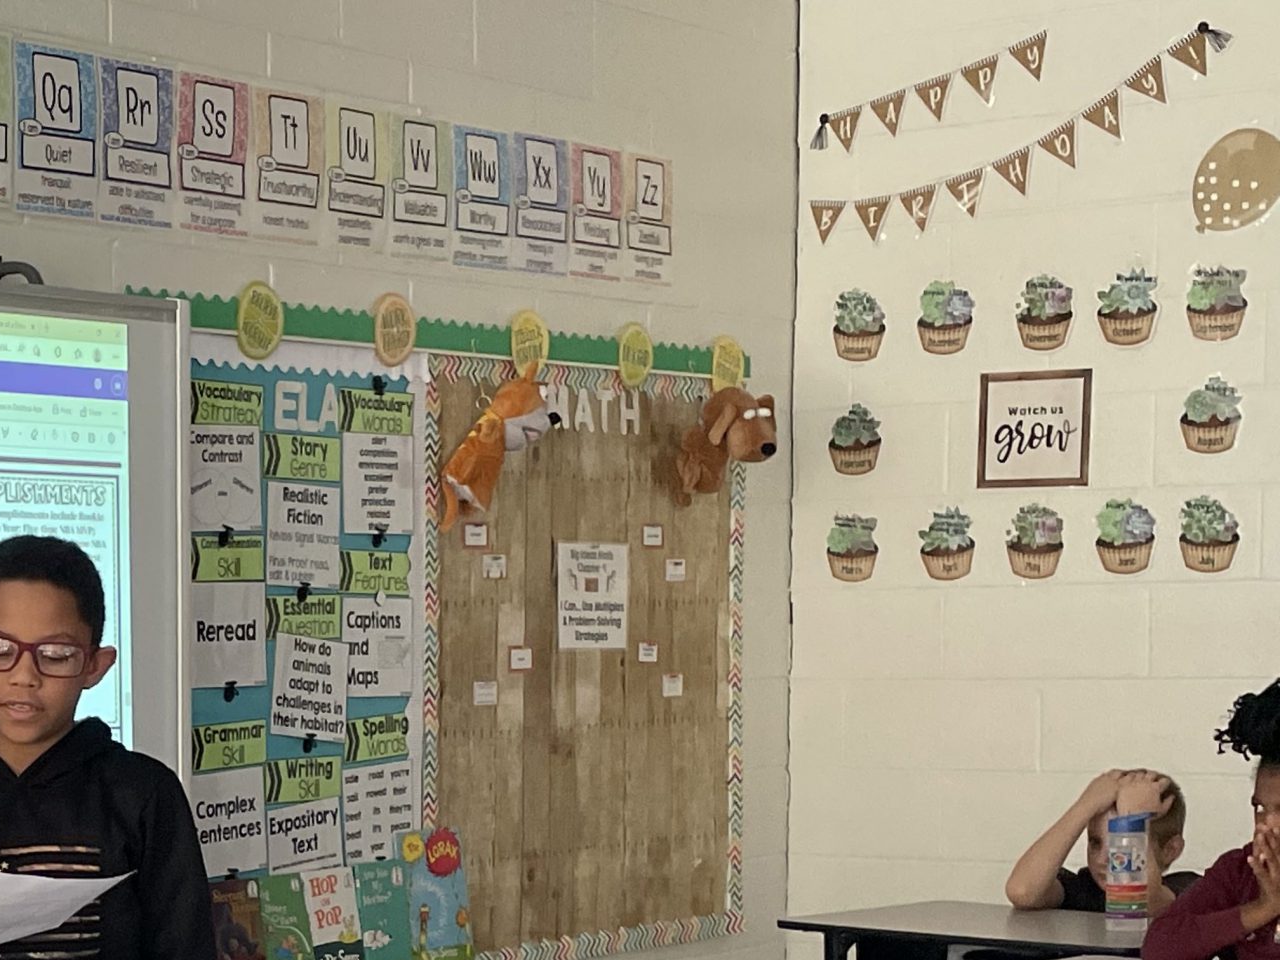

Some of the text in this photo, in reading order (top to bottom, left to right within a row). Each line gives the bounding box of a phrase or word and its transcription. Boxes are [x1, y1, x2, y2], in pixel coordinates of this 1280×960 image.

[42, 72, 74, 124] Qq
[126, 87, 151, 127] Rr
[201, 98, 226, 139] Ss
[280, 114, 298, 149] Tt
[45, 143, 73, 165] Quiet
[346, 126, 369, 163] Uu
[410, 138, 430, 173] Vv
[469, 148, 496, 185] Ww
[532, 155, 552, 190] Xx
[191, 166, 234, 195] Strategic
[588, 165, 606, 208] Yy
[640, 174, 659, 207] Zz
[197, 382, 264, 408] Vocabulary
[274, 380, 340, 433] ELA
[352, 391, 413, 417] Vocabulary
[1008, 405, 1065, 417] Watch us
[361, 413, 403, 434] Words
[236, 431, 254, 446] and
[291, 437, 328, 462] Story
[994, 418, 1078, 464] grow
[201, 448, 243, 465] Contrast
[289, 459, 328, 479] Genre
[282, 486, 329, 506] Realistic
[286, 508, 324, 527] Fiction
[368, 553, 393, 572] Text
[353, 571, 409, 591] Features
[282, 598, 336, 616] Essential
[196, 620, 257, 643] Reread
[346, 610, 401, 634] Captions
[293, 638, 331, 657] How do
[292, 657, 331, 677] animals
[288, 676, 332, 695] adapt to
[274, 694, 343, 716] challenges in
[203, 724, 265, 745] Grammar
[272, 711, 345, 734] their habitat?
[362, 715, 409, 738] Spelling
[367, 738, 407, 757] Words
[285, 758, 333, 781] Writing
[195, 796, 257, 820] Complex
[198, 820, 262, 845] entences
[269, 807, 338, 838] Expository
[291, 833, 319, 856] Text
[425, 835, 459, 865] LORAX
[309, 874, 338, 899] HOP
[314, 905, 343, 930] POP
